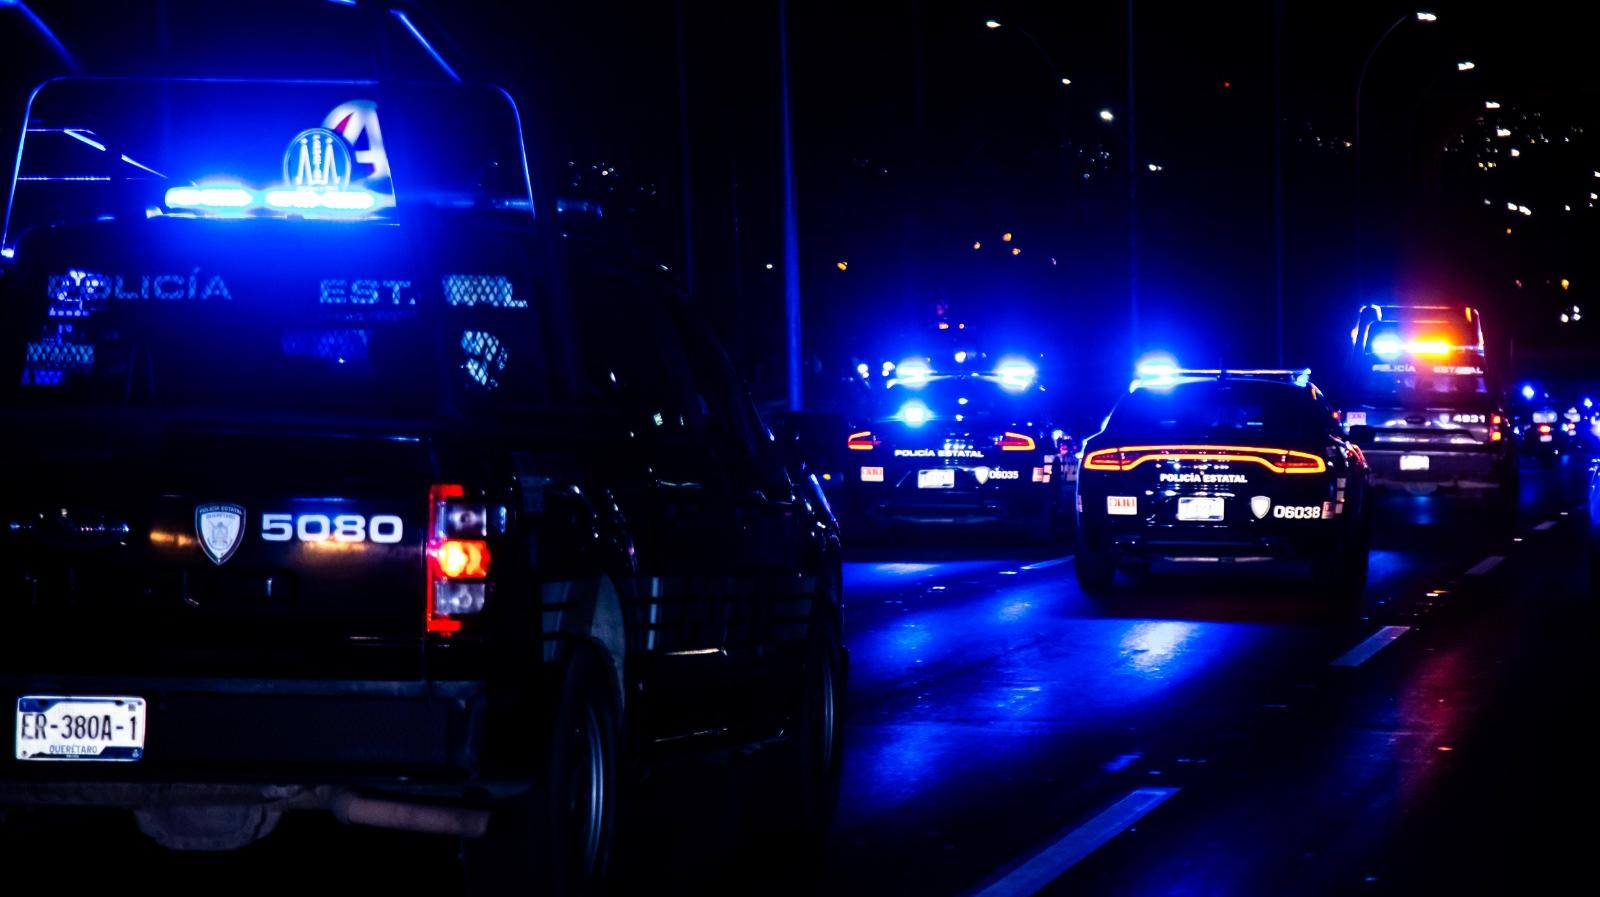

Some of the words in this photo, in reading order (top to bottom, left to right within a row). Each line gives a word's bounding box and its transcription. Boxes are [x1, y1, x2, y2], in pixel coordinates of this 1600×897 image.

[894, 449, 936, 457] POLICÍA
[937, 450, 984, 458] ESTATAL
[1159, 472, 1202, 483] POLICÍA
[1203, 474, 1248, 484] ESTATAL
[1273, 505, 1321, 519] 06038
[261, 514, 404, 544] 5080
[21, 713, 137, 741] ER-380A-1
